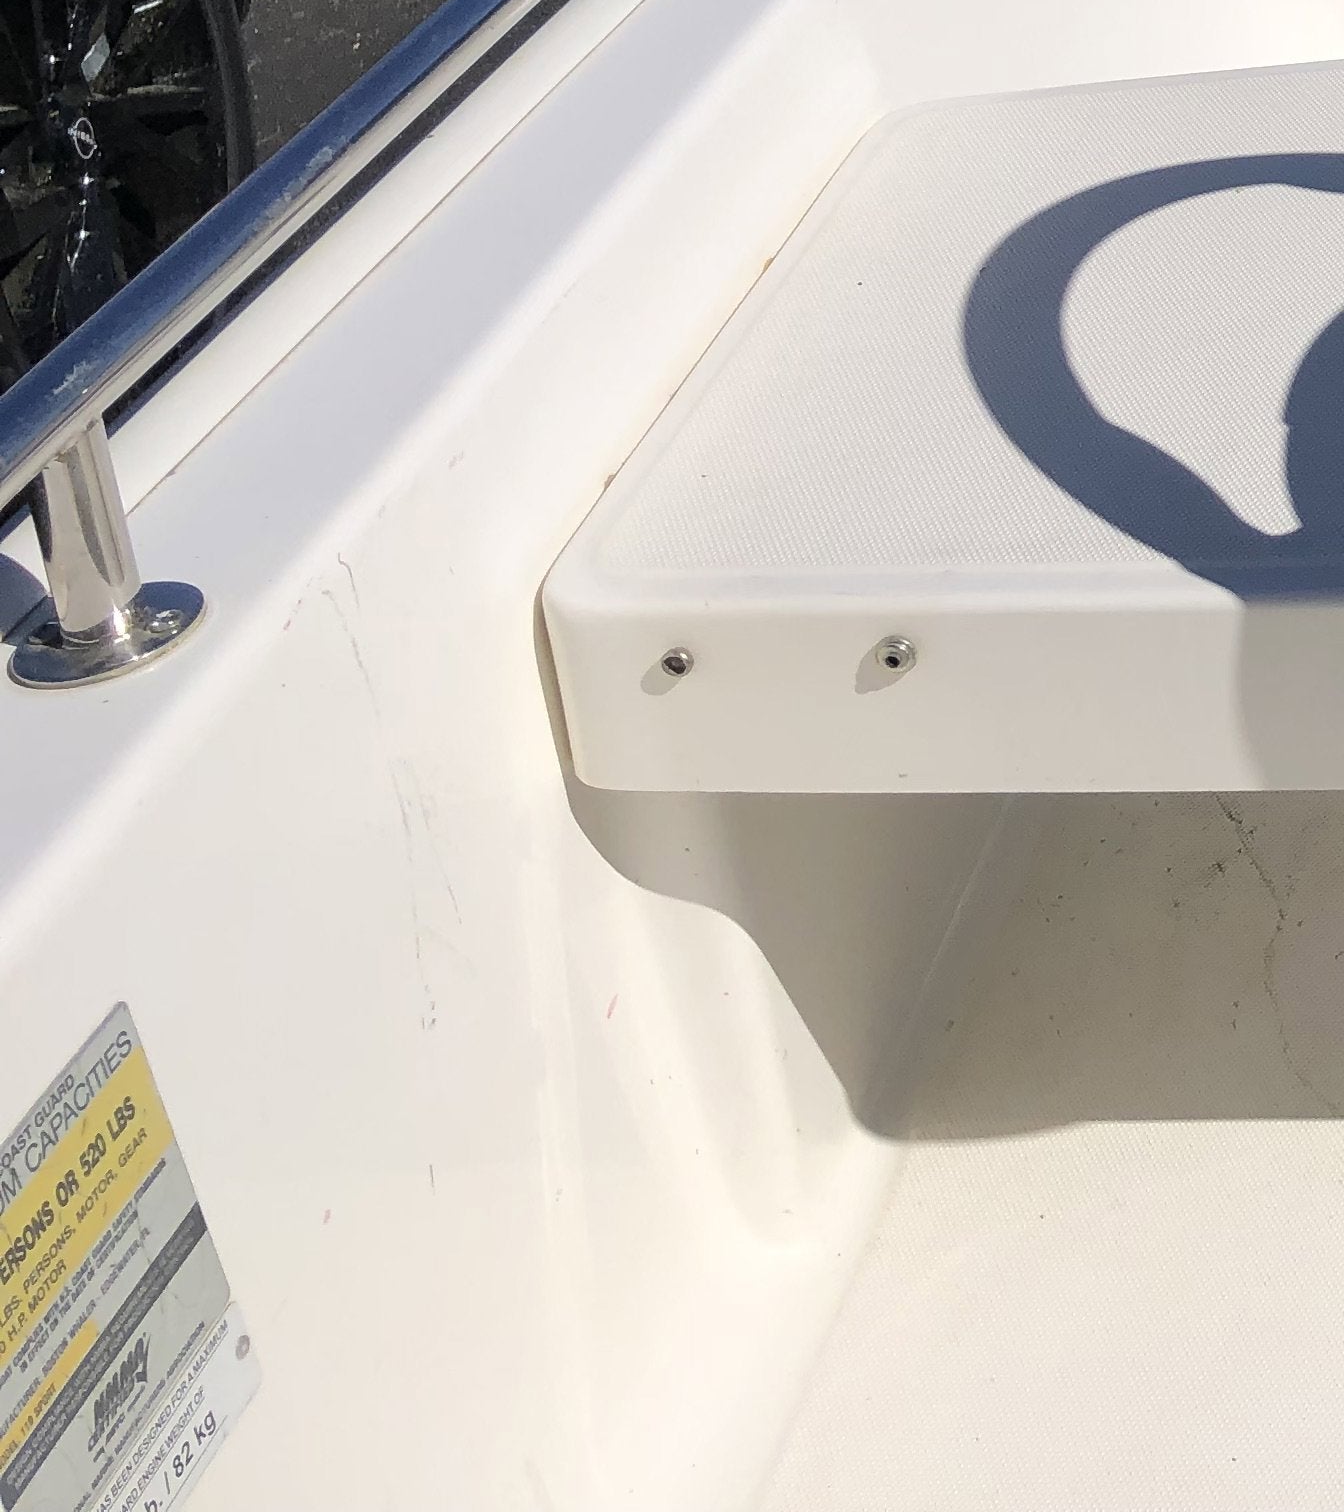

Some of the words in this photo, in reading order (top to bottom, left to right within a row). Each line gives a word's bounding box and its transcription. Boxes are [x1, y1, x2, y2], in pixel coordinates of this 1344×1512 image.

[0, 1125, 32, 1170] OAST
[34, 1074, 75, 1128] GUARD
[25, 1030, 133, 1173] CAPACITIES
[118, 1127, 148, 1168] GEAR
[55, 1169, 80, 1207] OR
[79, 1132, 107, 1177] 520
[106, 1095, 136, 1141] LBS
[28, 1259, 67, 1314] MOTOR
[111, 1465, 133, 1496] BEEN
[132, 1404, 172, 1465] DESIGNED
[171, 1380, 187, 1408] FOR
[192, 1319, 229, 1372] MAXIMUM
[137, 1444, 167, 1490] ENGINE
[165, 1400, 201, 1449] WEIGHT
[172, 1440, 194, 1478] 82
[193, 1410, 217, 1446] kg
